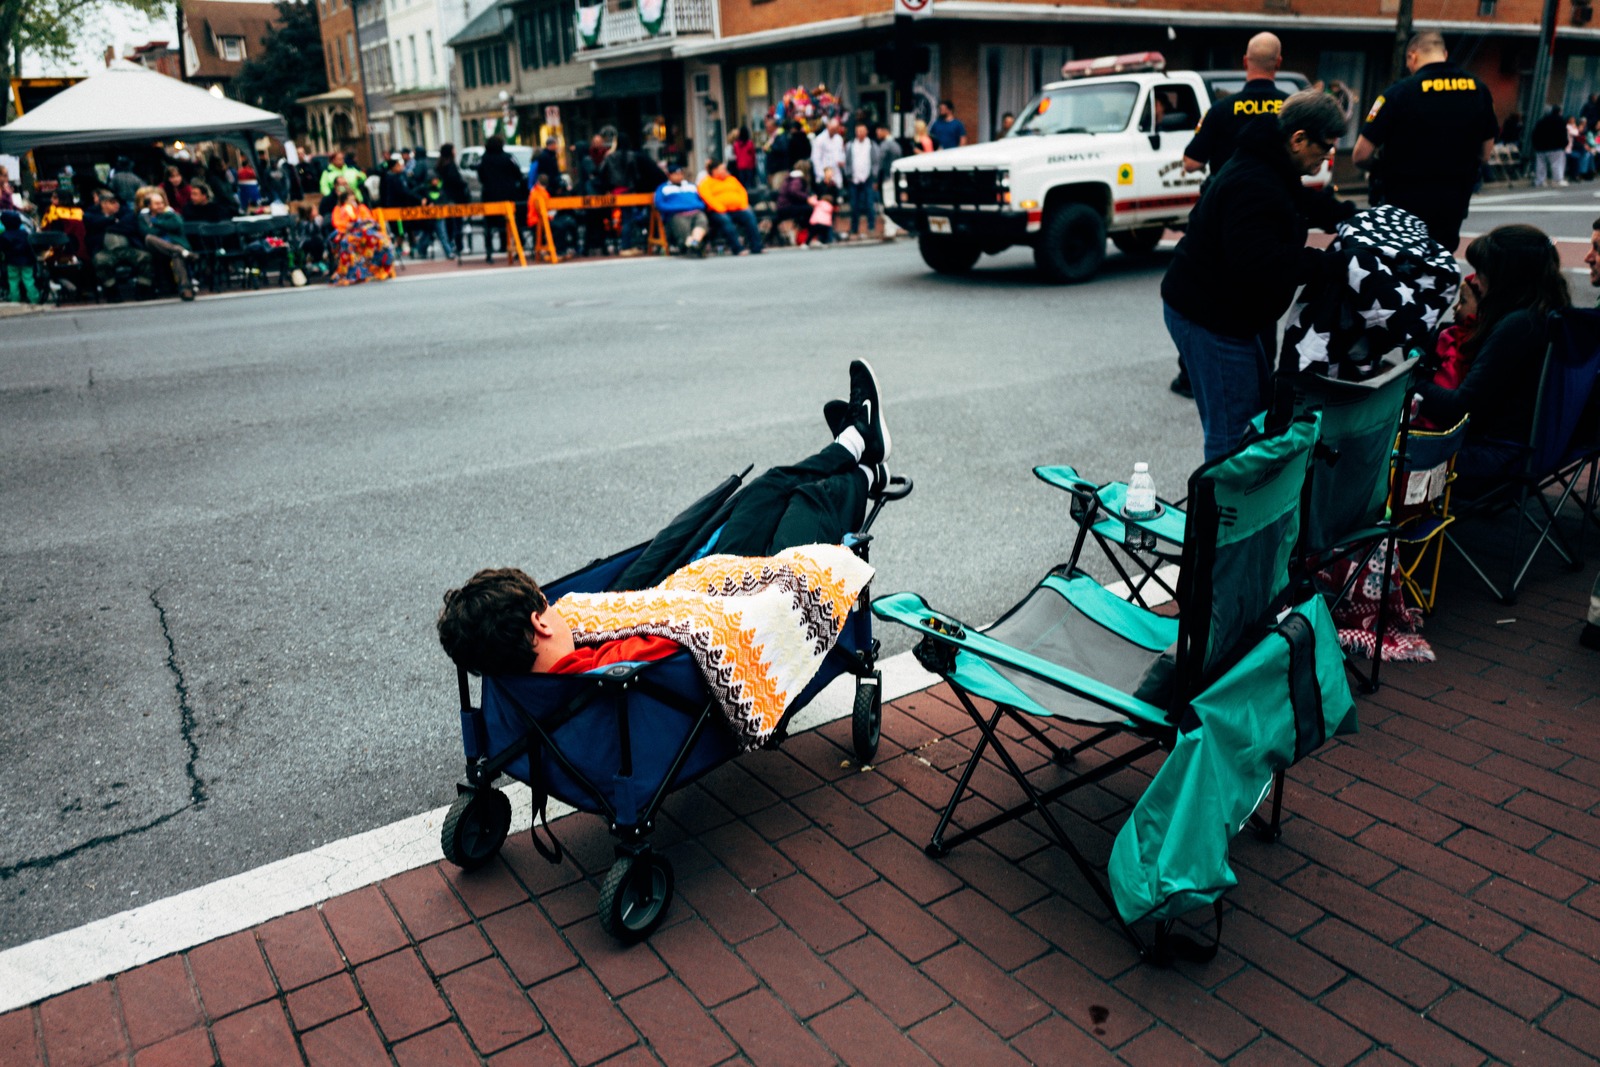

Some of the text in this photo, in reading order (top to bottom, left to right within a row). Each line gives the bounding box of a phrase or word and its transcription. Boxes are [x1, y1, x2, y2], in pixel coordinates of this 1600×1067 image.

[1421, 78, 1477, 93] POLICE
[1233, 99, 1283, 116] POLICE
[400, 203, 486, 219] DO NOT ENTER
